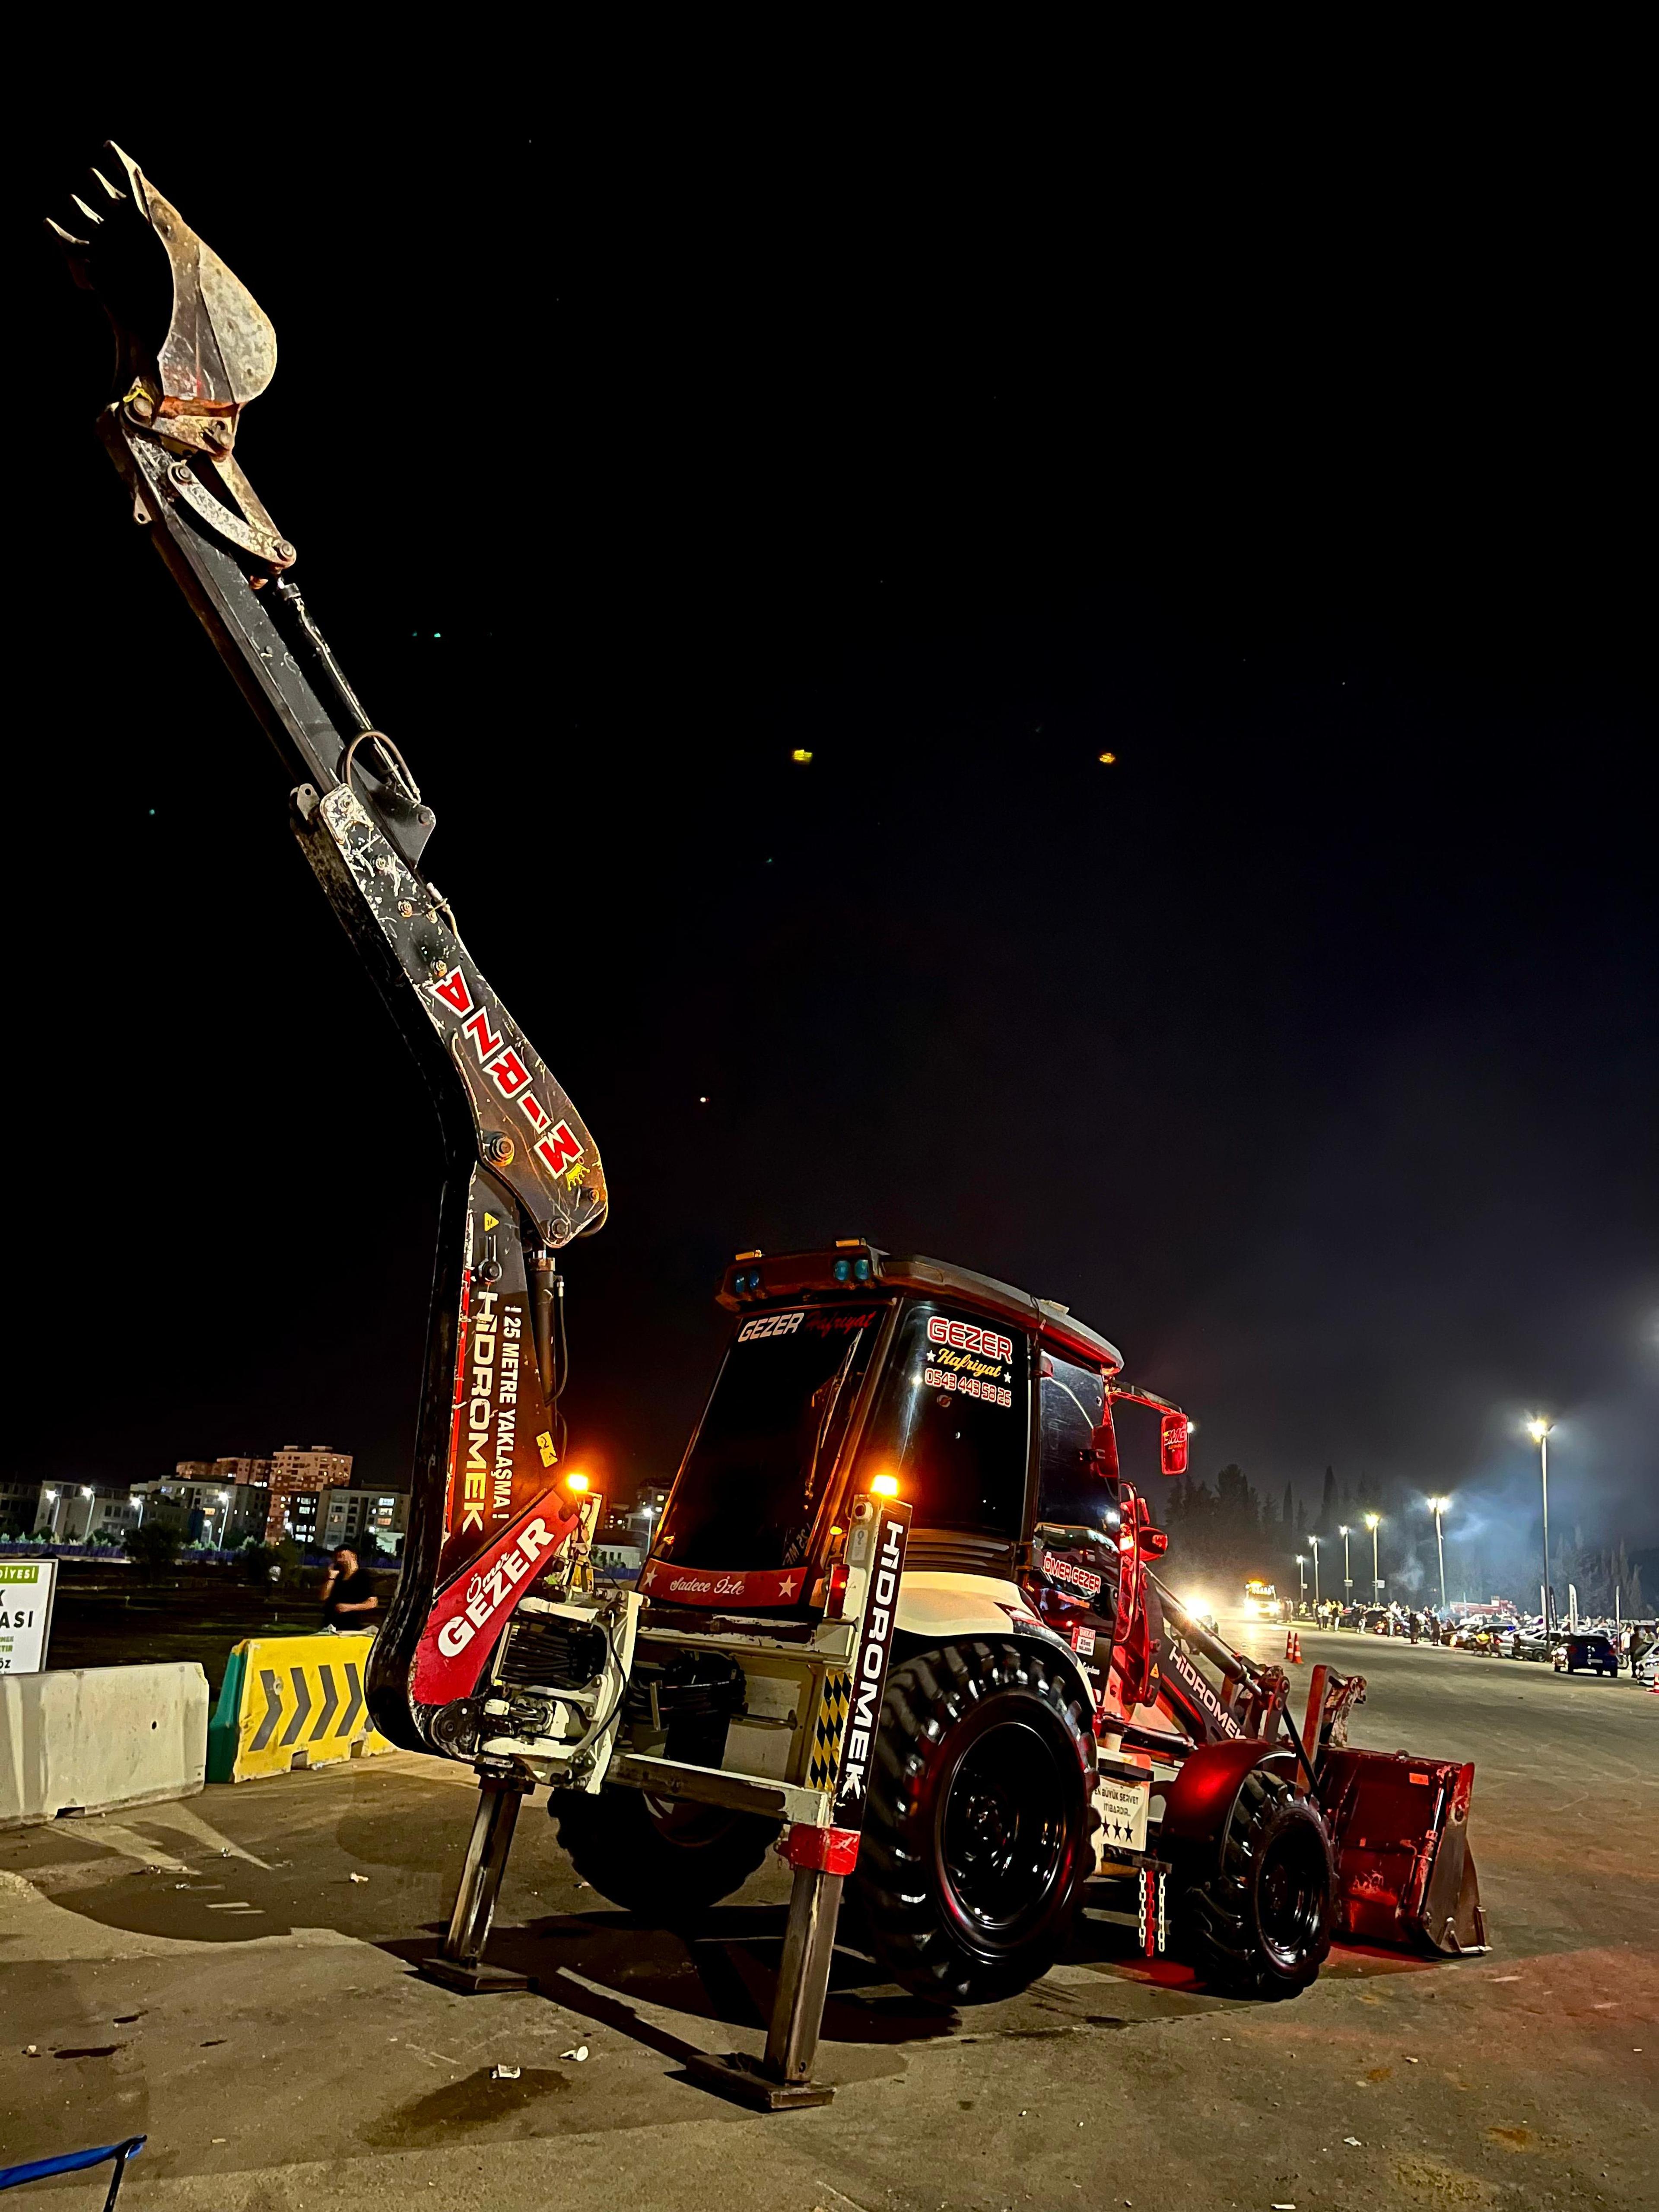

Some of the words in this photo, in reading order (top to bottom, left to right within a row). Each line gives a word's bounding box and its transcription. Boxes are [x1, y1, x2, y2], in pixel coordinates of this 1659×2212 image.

[503, 1318, 521, 1338] 25
[738, 1313, 804, 1342] GEZER
[927, 1316, 1013, 1364] GEZER
[499, 1342, 520, 1404] METRE
[937, 1348, 1002, 1377] Hafriyat
[925, 1368, 957, 1391] 0543
[958, 1376, 981, 1398] 443
[981, 1382, 997, 1402] 58
[997, 1387, 1012, 1408] 26
[490, 1408, 519, 1509] YAKLAŞMA
[438, 1518, 555, 1657] GEZER
[466, 1551, 510, 1603] Ömer
[670, 1577, 711, 1592] Sadece
[714, 1576, 744, 1595] İzle
[1043, 1551, 1071, 1583] ÖMER
[1071, 1567, 1101, 1594] GEZER
[1119, 1792, 1138, 1805] SERVET
